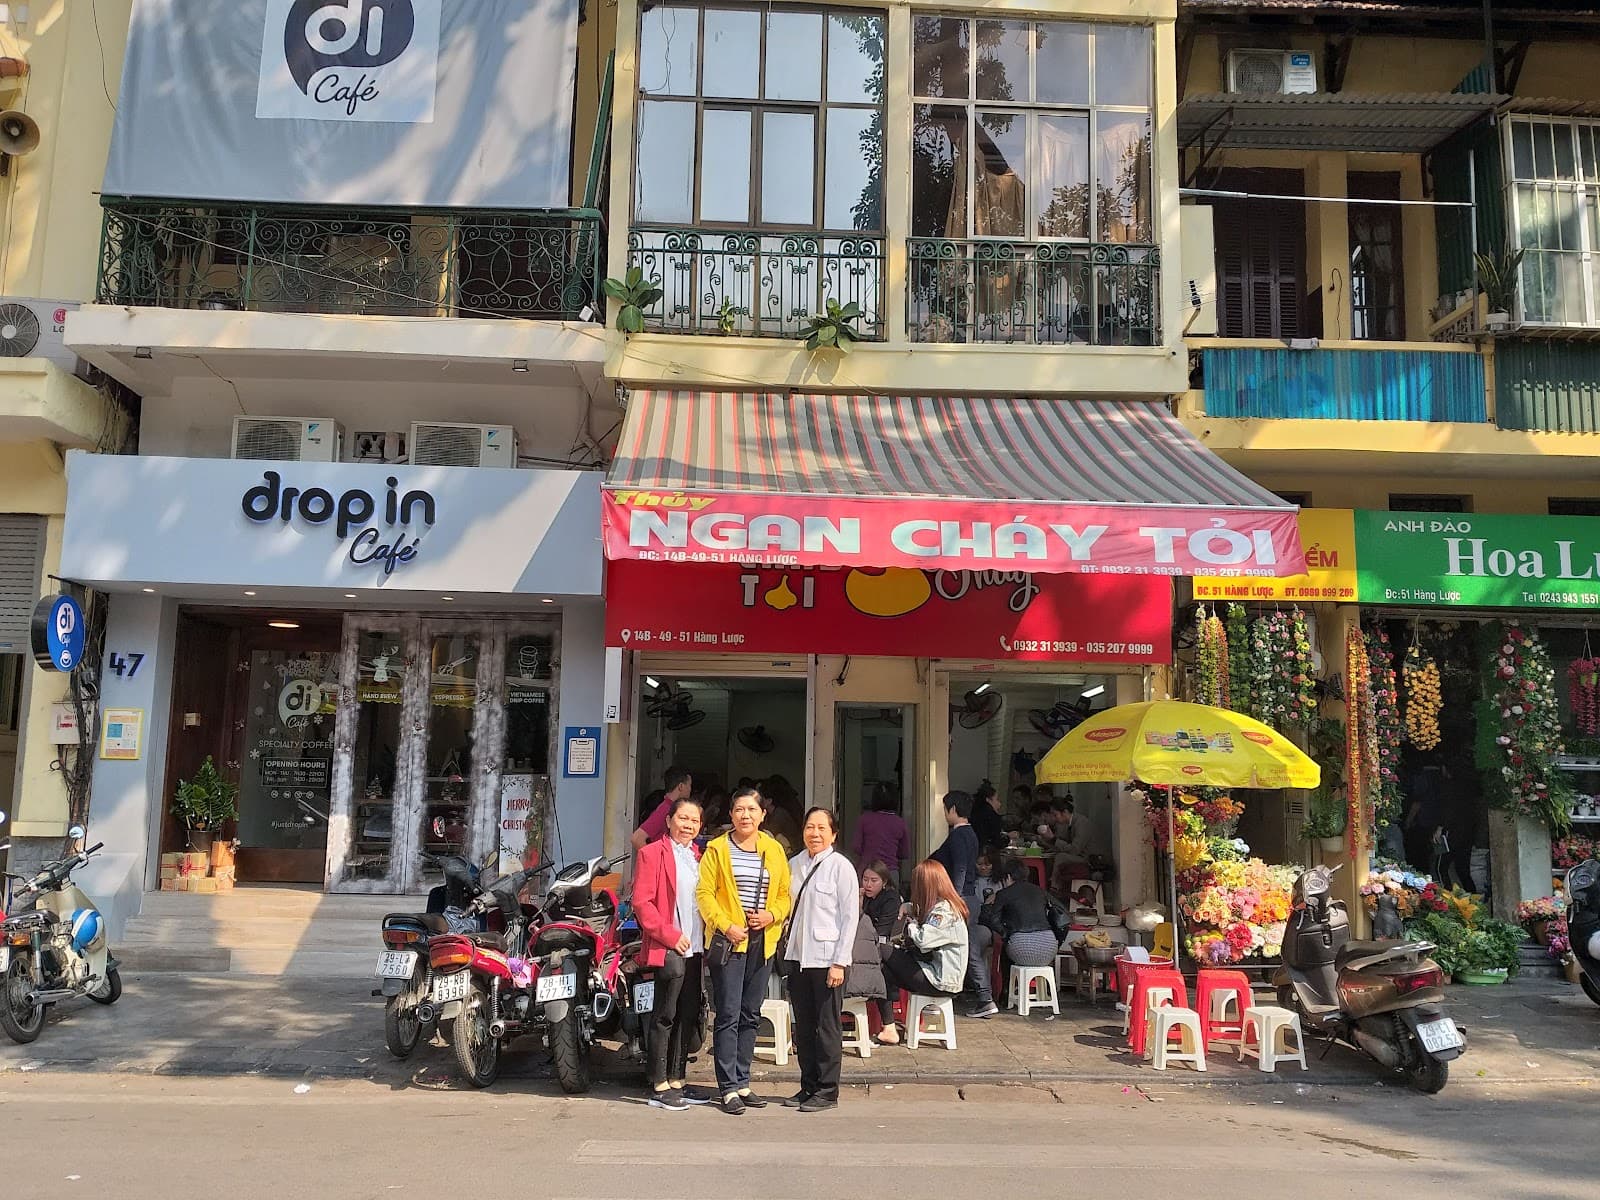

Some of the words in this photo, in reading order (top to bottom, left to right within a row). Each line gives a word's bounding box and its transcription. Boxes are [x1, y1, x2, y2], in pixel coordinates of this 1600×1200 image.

[314, 74, 379, 116] Café
[241, 471, 375, 539] drop
[386, 476, 436, 526] in
[613, 489, 717, 511] Thủy
[1384, 520, 1425, 533] ANH
[1429, 517, 1471, 534] ĐÀO
[629, 509, 860, 554] NGAN
[891, 515, 1109, 562] CHÁY
[1139, 517, 1278, 565] TỎI
[349, 527, 420, 575] Café
[663, 551, 725, 562] 14B-49-51
[1442, 537, 1546, 579] Hoa
[1224, 584, 1250, 597] HÀNG
[1413, 588, 1436, 602] Hàng
[1439, 590, 1461, 604] Lược
[1522, 591, 1537, 602] Tel
[1540, 592, 1561, 603] 0243
[1562, 593, 1578, 604] 943
[1580, 593, 1599, 605] 1551
[60, 607, 71, 629] di
[633, 630, 651, 641] 14B
[659, 631, 672, 642] 49
[679, 632, 690, 642] 51
[693, 631, 718, 645] Hàng
[721, 632, 745, 646] Lược
[1013, 640, 1038, 652] 0932
[1040, 640, 1051, 652] 31
[1052, 641, 1078, 653] 3939
[1086, 642, 1105, 653] 035
[1107, 643, 1126, 654] 207
[1128, 643, 1153, 655] 9999
[109, 652, 145, 677] 47
[285, 684, 312, 711] di
[434, 693, 465, 701] ESPRESSO
[287, 716, 309, 732] Café
[258, 739, 300, 749] SPECIALTY
[301, 740, 335, 749] COFFEE
[266, 760, 299, 768] OPENING
[300, 761, 326, 769] HOURS
[381, 963, 408, 976] 7560
[437, 985, 464, 1001] 8396
